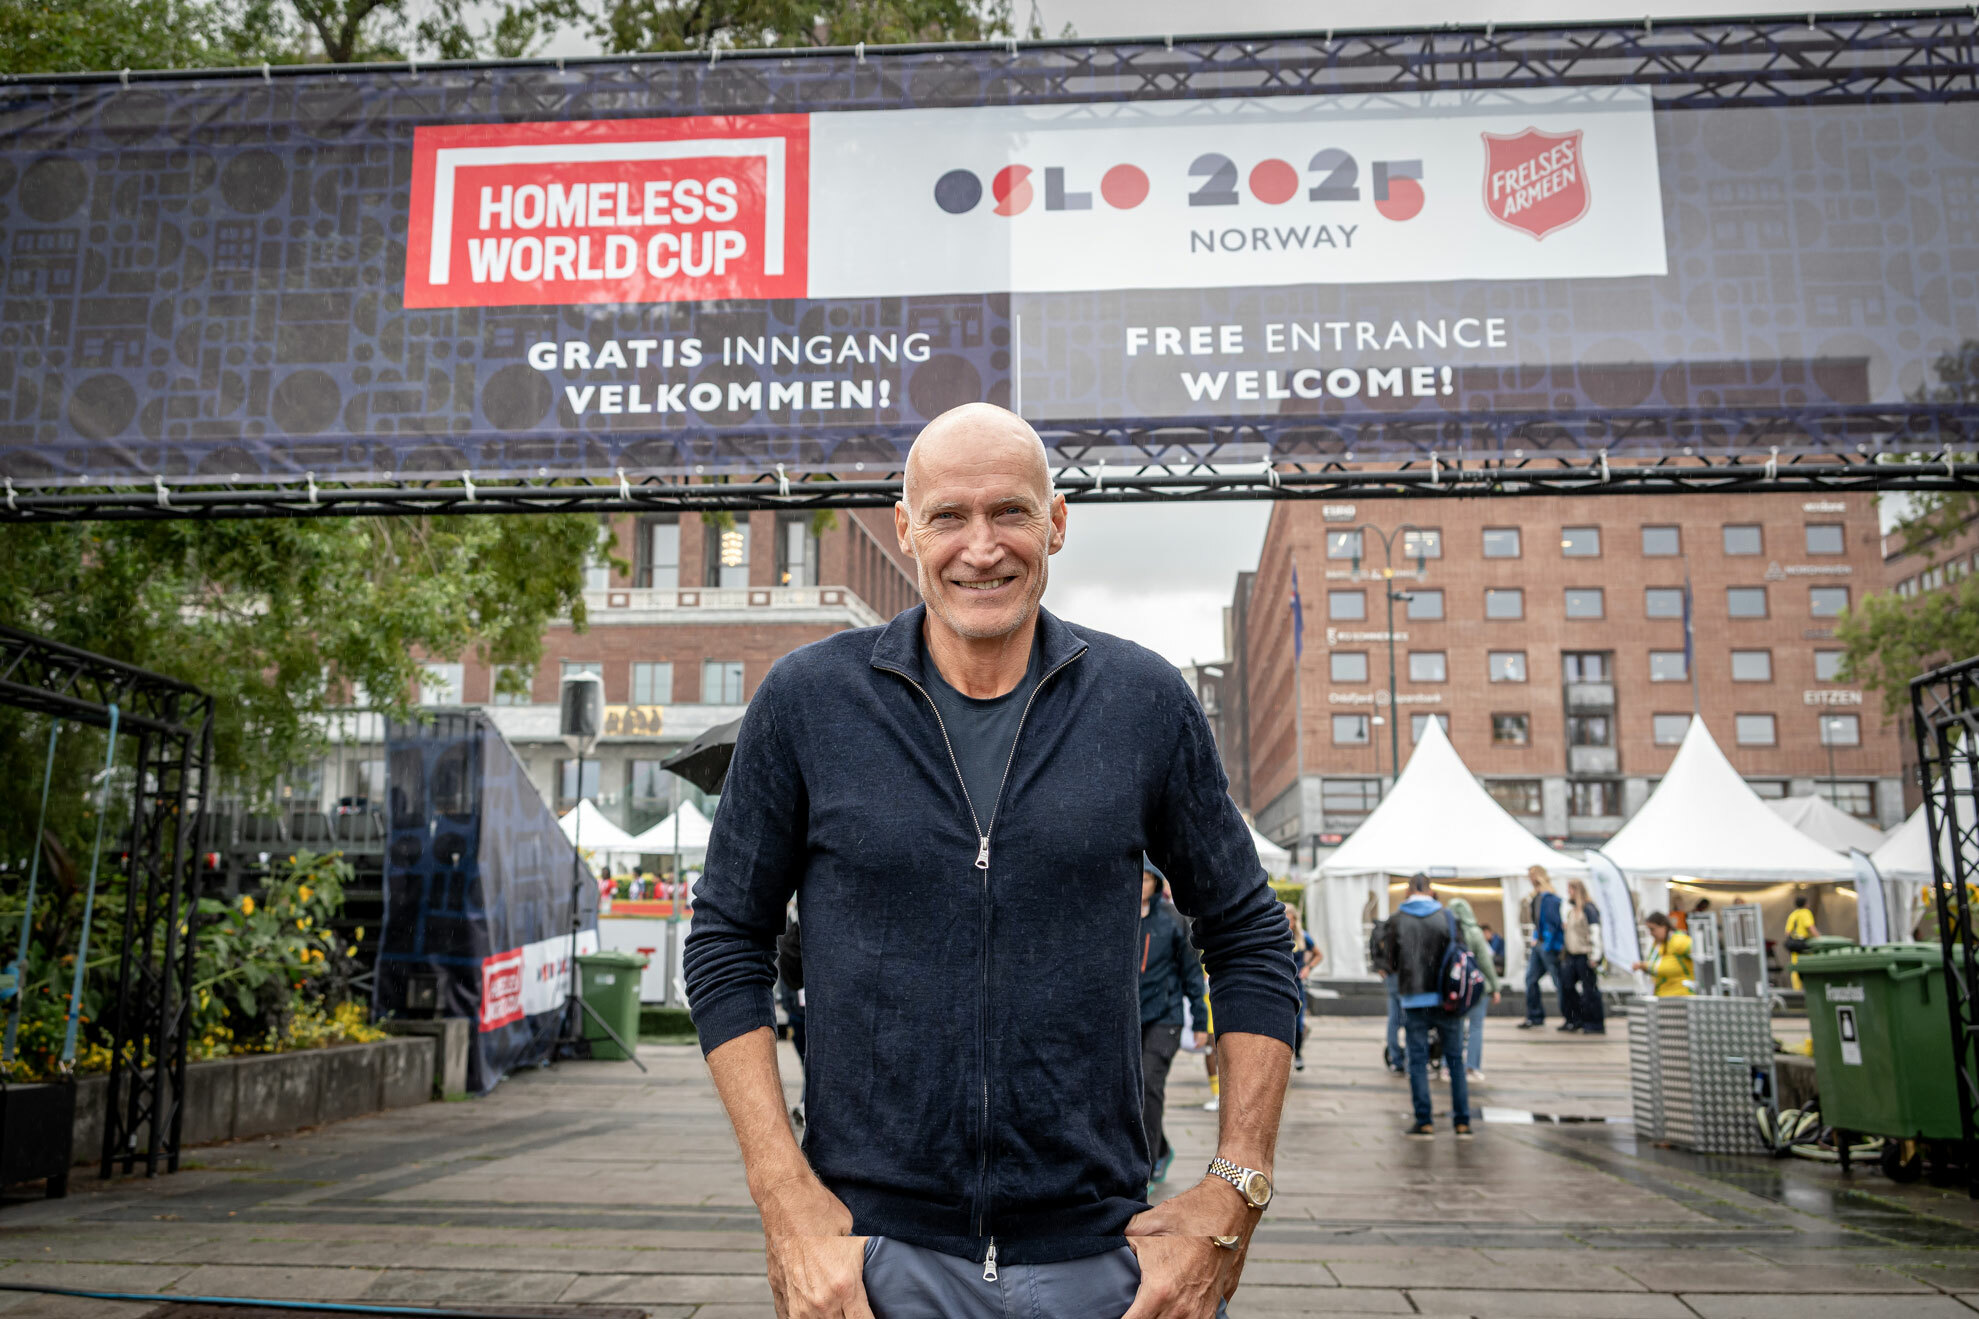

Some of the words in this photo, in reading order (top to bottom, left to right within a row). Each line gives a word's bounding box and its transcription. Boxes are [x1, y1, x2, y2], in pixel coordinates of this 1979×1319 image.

[479, 177, 741, 231] HOMELESS
[934, 164, 1149, 217] OSLO
[1188, 147, 1424, 221] 2025
[1503, 163, 1576, 218] ARMEEN
[467, 234, 638, 285] WORLD
[643, 229, 747, 279] CUP
[1190, 225, 1358, 253] NORWAY
[527, 337, 702, 372] GRATIS
[723, 332, 932, 368] INNGANG
[1126, 325, 1244, 357] FREE
[1265, 317, 1508, 353] ENTRANCE
[564, 379, 892, 415] VELKOMMEN!
[1180, 365, 1455, 402] WELCOME!
[1803, 690, 1862, 705] EITZEN
